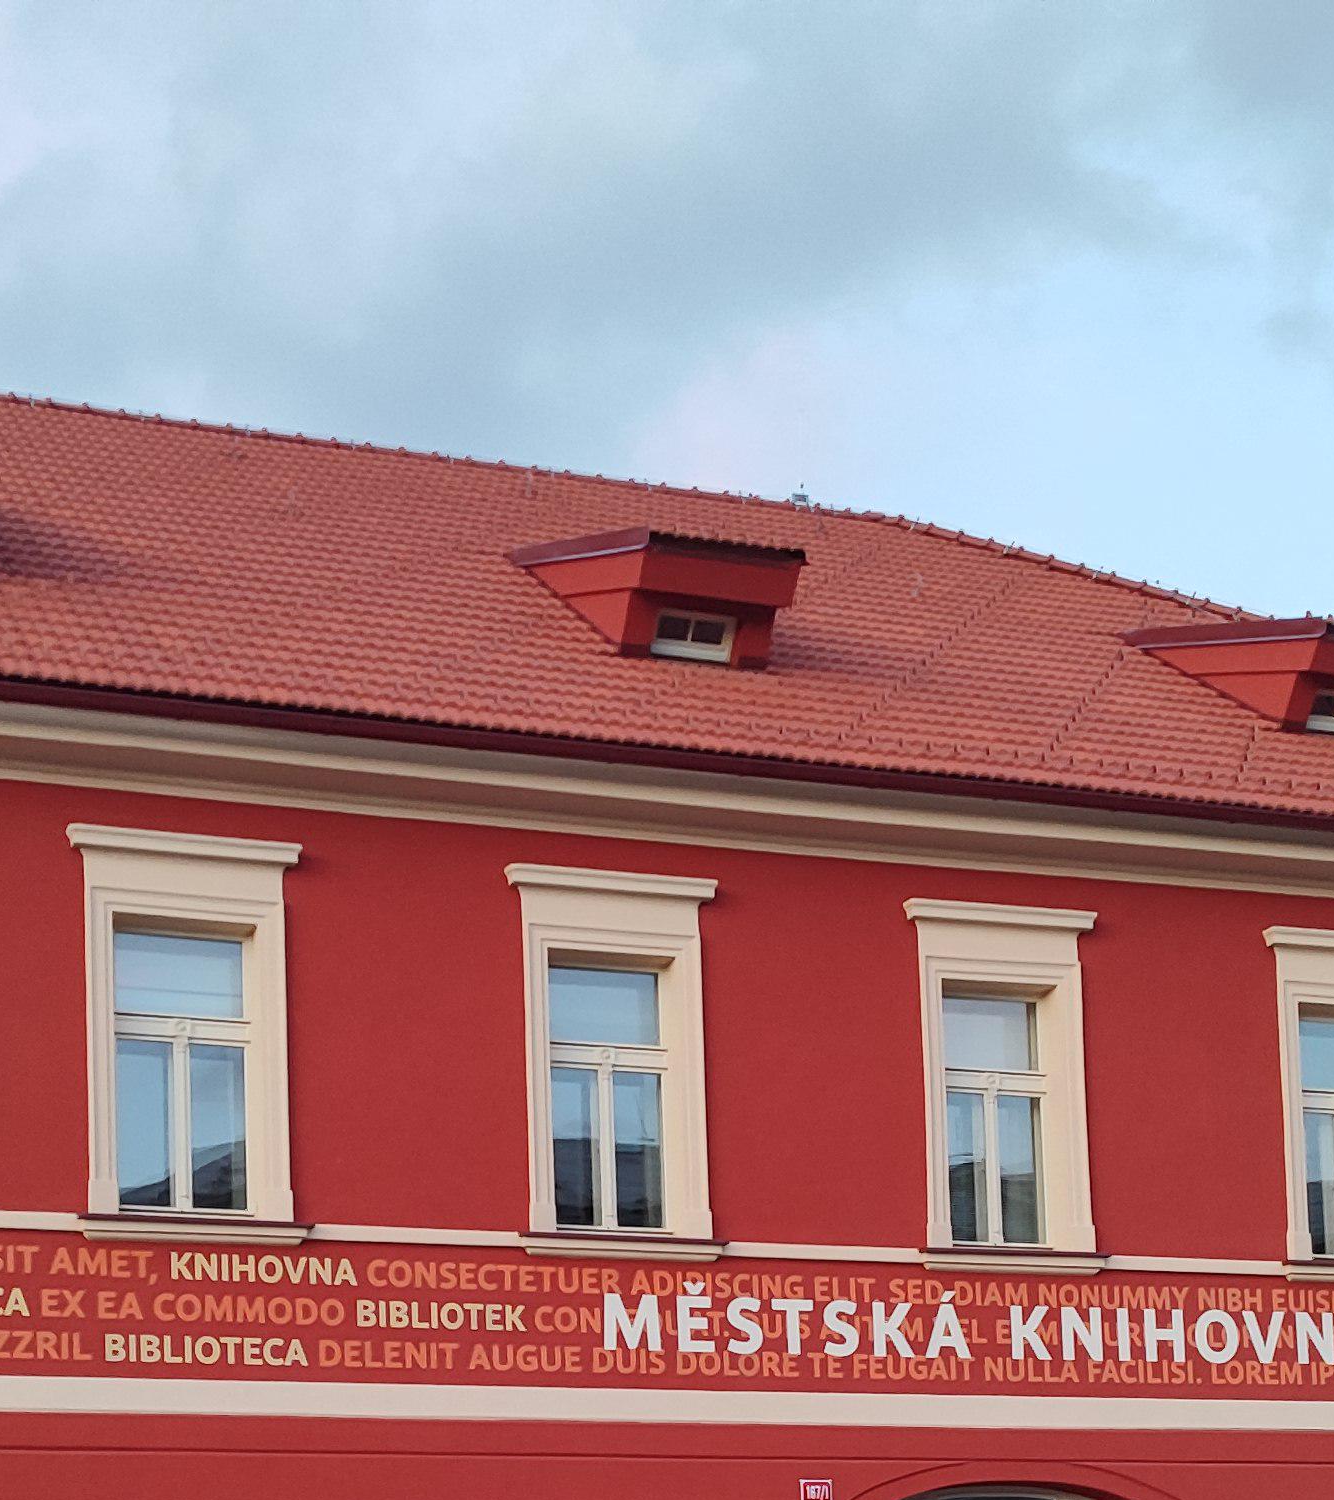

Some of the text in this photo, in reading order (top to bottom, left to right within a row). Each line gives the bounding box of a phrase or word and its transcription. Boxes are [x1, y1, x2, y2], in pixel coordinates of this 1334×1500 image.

[41, 1289, 85, 1317] EX
[98, 1291, 143, 1319] EA
[154, 1293, 344, 1326] COMMODO
[357, 1300, 526, 1331] BIBLIOTEK
[50, 1247, 157, 1284] AMET,
[171, 1252, 357, 1286] KNIHOVNA
[367, 1259, 621, 1297] CONSECTETUER
[889, 1278, 944, 1304] SED
[953, 1281, 1028, 1308] DIAM
[1039, 1284, 1189, 1314] NONUMMY
[1198, 1288, 1262, 1316] NIBH
[603, 1281, 972, 1360] MĚSTSKÁ
[105, 1334, 308, 1366] BIBLIOTECA
[319, 1340, 459, 1369] DELENIT
[470, 1344, 582, 1372] AUGUE
[593, 1342, 665, 1374] DUIS
[677, 1345, 801, 1377] DOLORE
[807, 1352, 843, 1378] TE
[850, 1349, 975, 1380] FEUGAIT
[984, 1353, 1079, 1382] NULLA
[1088, 1354, 1205, 1384] FACILISI.
[1211, 1360, 1304, 1385] LOREM
